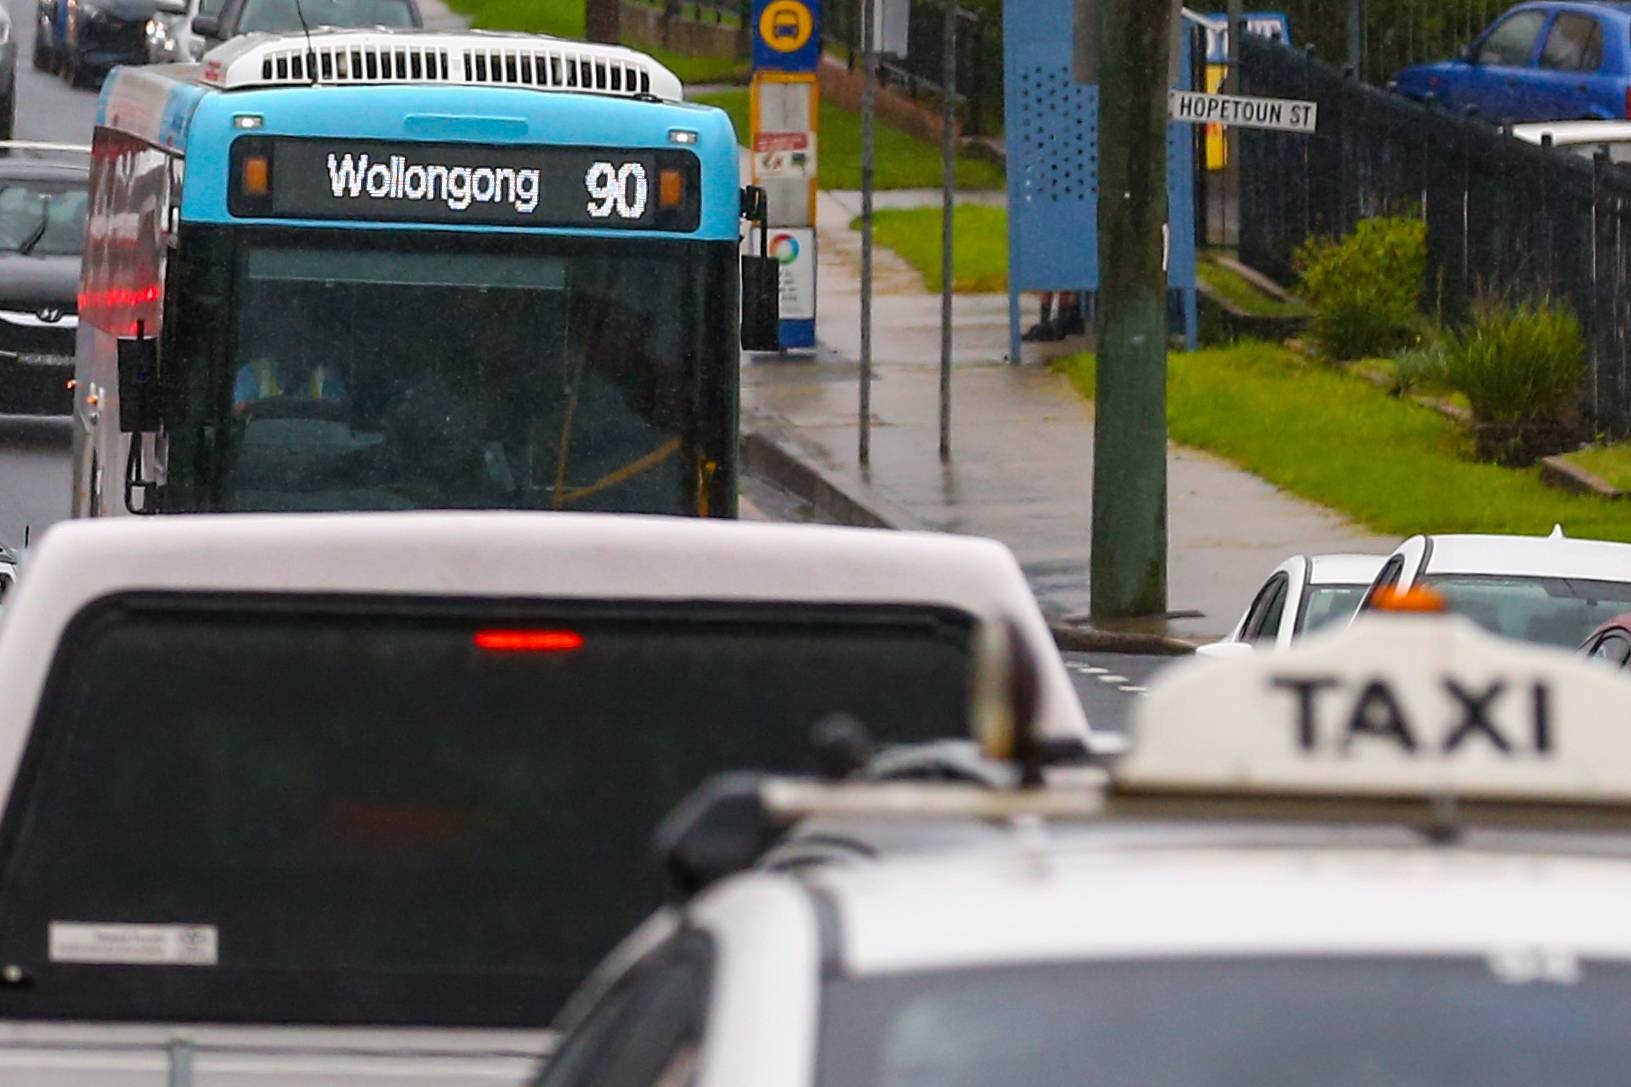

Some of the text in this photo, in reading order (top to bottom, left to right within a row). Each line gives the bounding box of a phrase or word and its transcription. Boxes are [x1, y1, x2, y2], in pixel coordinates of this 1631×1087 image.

[1179, 95, 1313, 128] HOPETOUN ST
[326, 152, 648, 220] Wollongong 90
[1269, 673, 1557, 756] TAXI
